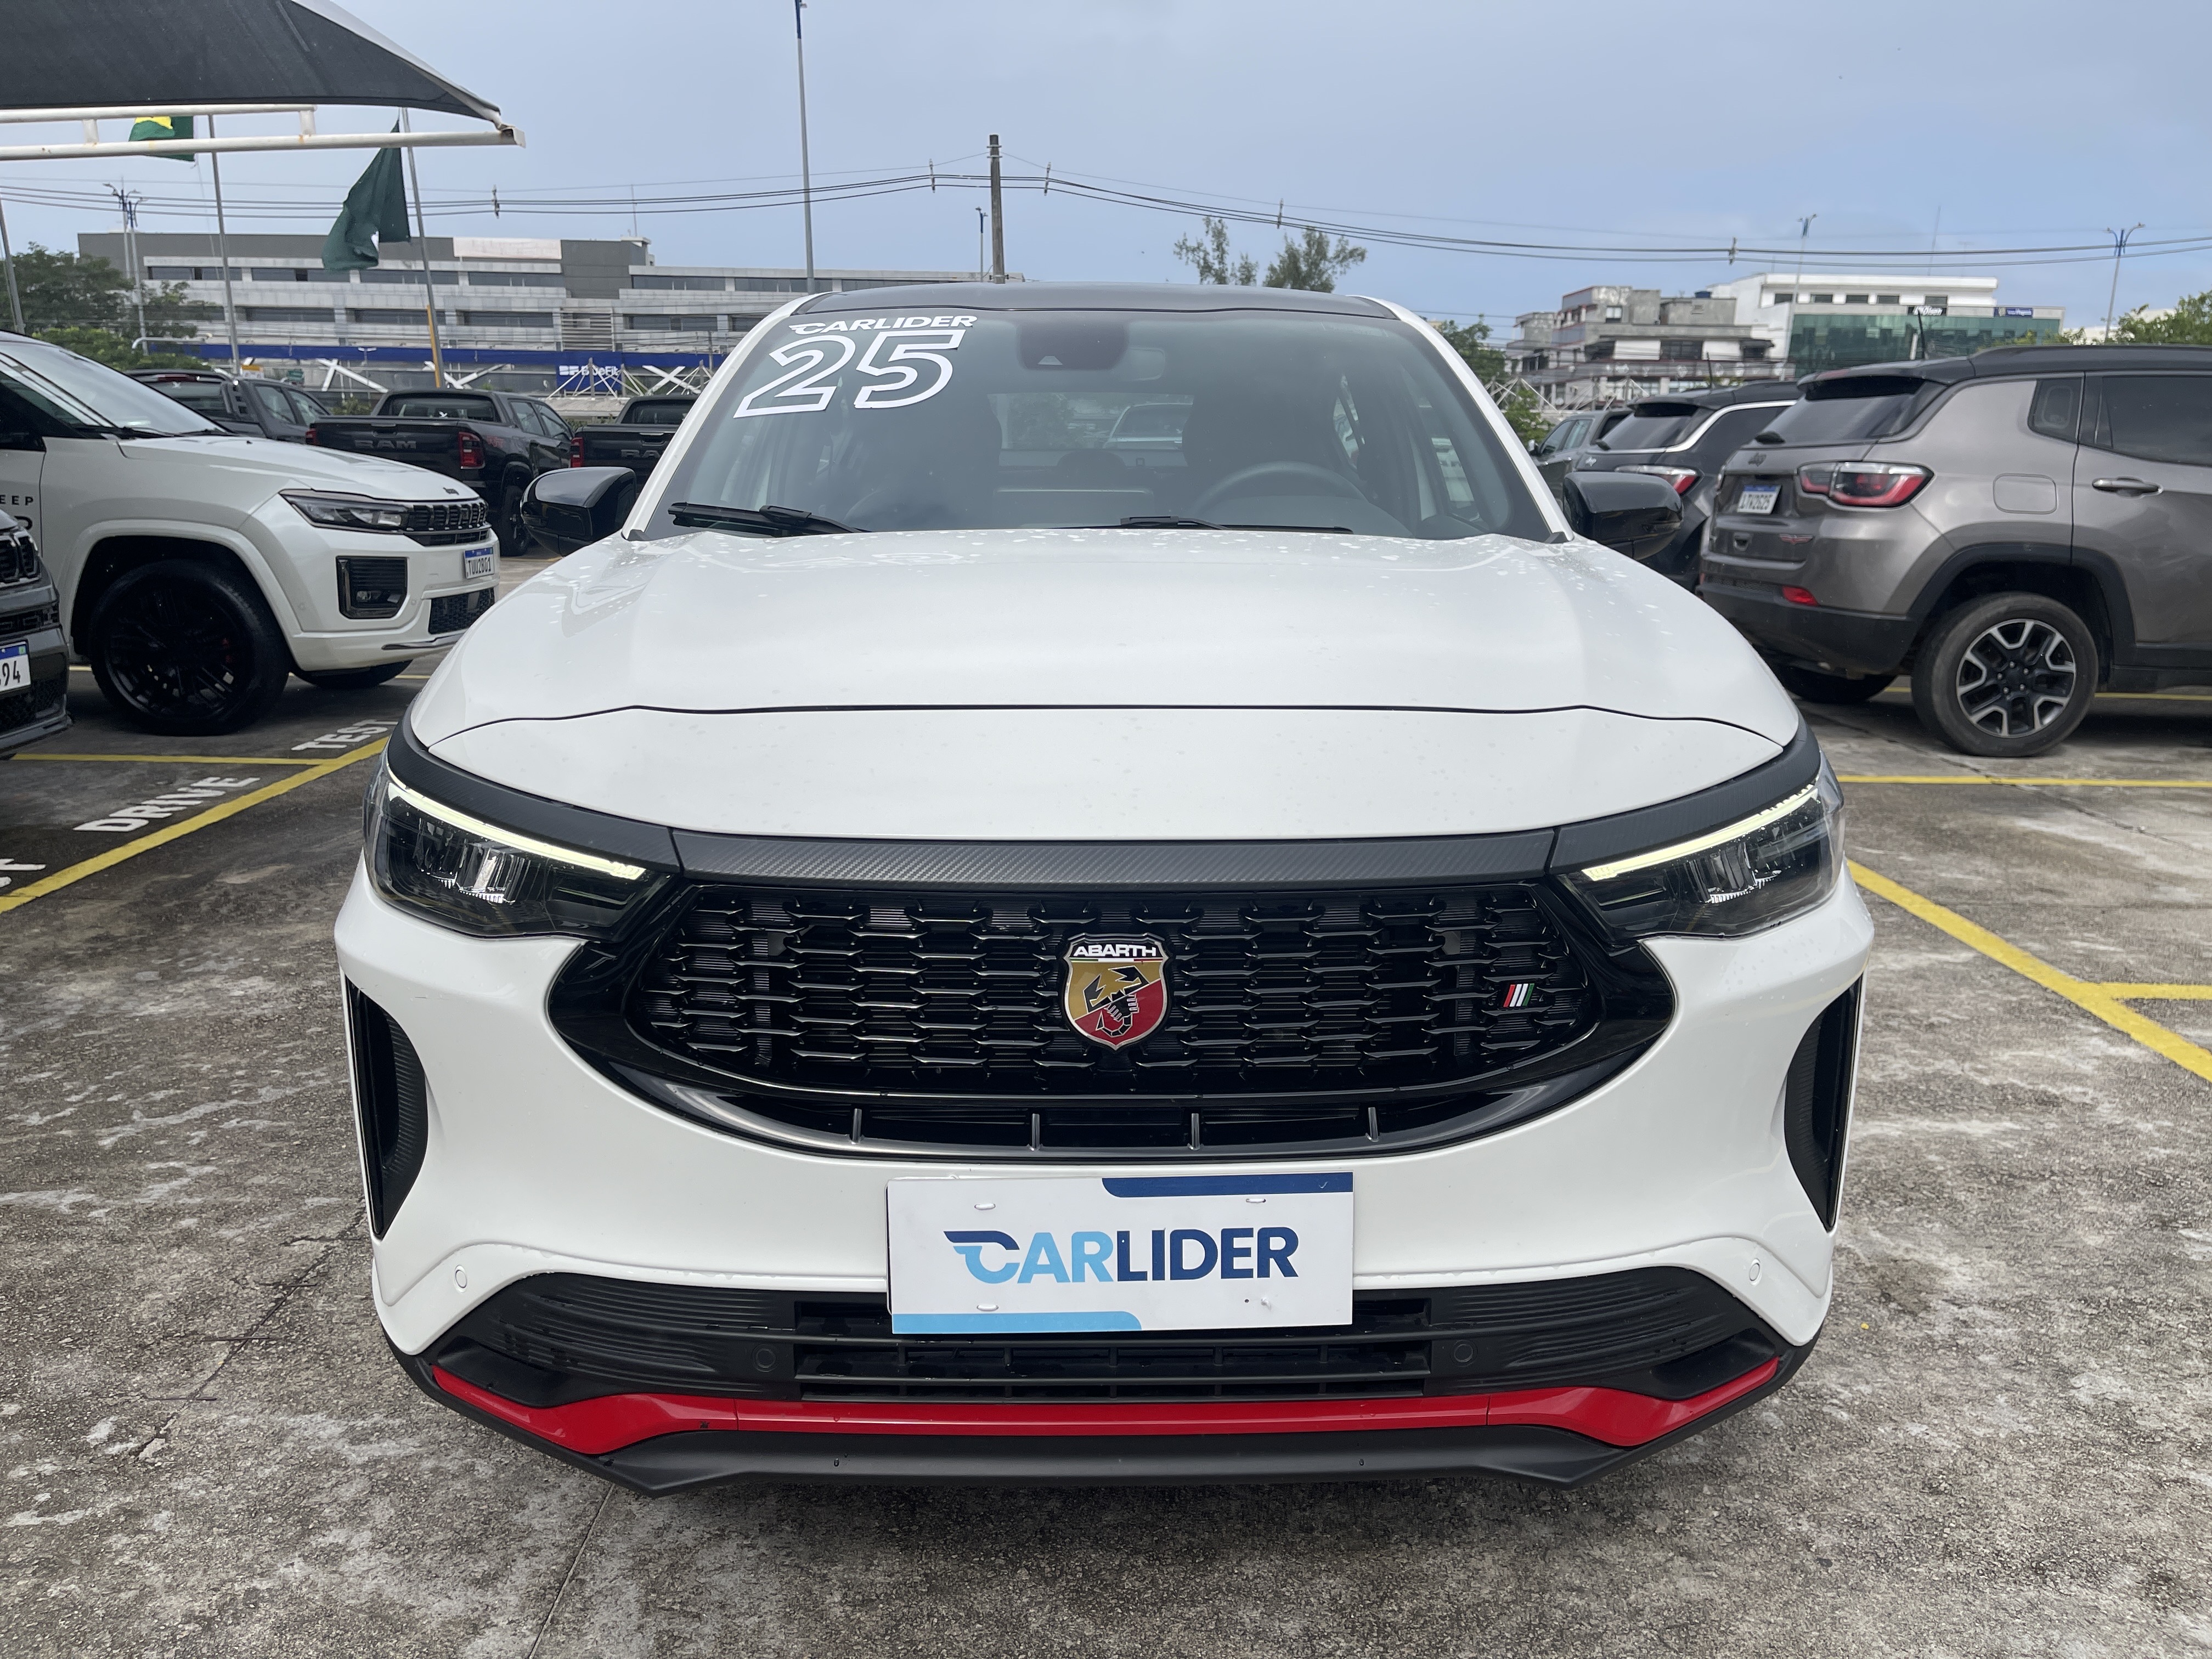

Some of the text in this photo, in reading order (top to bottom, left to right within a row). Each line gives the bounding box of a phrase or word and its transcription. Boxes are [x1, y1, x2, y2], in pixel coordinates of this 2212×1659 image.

[788, 315, 978, 335] CARLIDER
[581, 365, 618, 376] BueFit
[734, 329, 966, 419] 25
[354, 439, 416, 449] RAM
[620, 449, 663, 459] RA
[0, 660, 21, 687] 94
[72, 776, 261, 833] DRIVE
[291, 719, 399, 752] TEST
[1073, 944, 1156, 957] ABARTH
[943, 1226, 1299, 1284] CARLIDER
